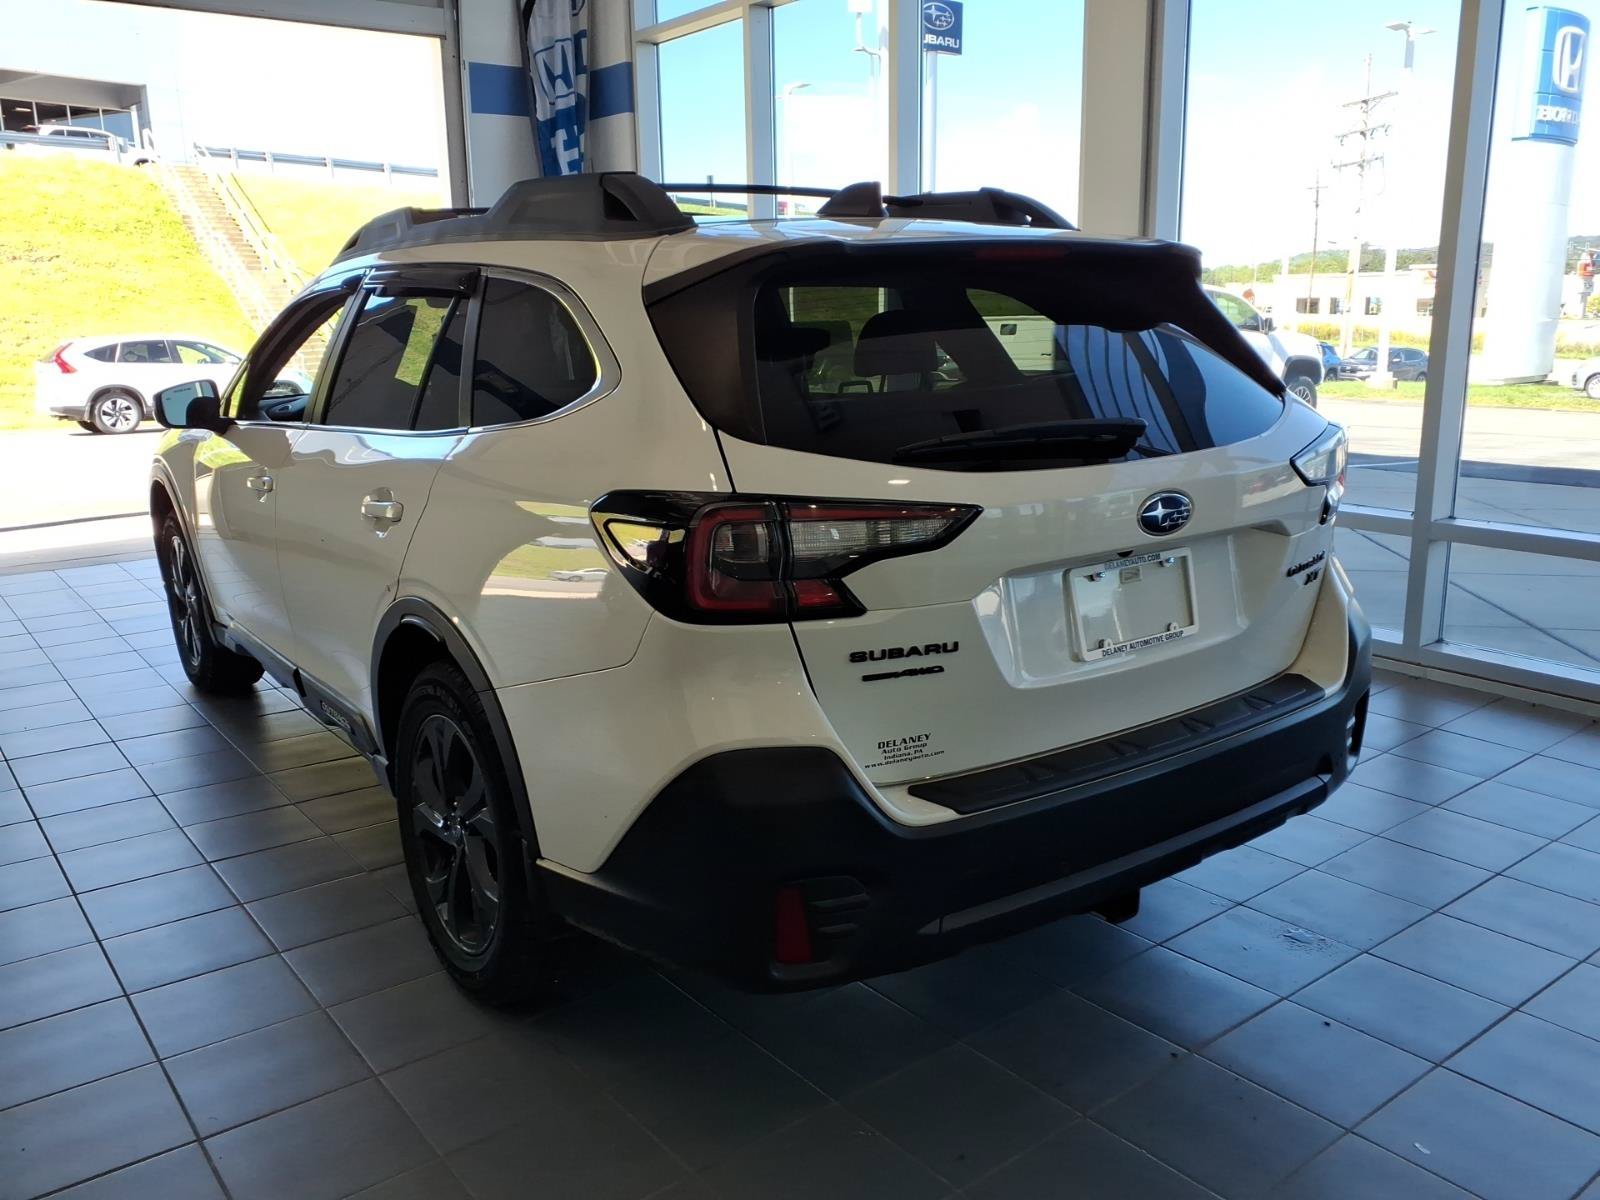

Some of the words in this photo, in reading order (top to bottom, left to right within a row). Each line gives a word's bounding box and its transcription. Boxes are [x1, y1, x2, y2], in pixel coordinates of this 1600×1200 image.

[924, 33, 960, 48] UBARU
[1102, 642, 1128, 656] DELANEY
[1129, 634, 1164, 649] AUTOMOTIVE
[1165, 630, 1184, 640] GROUP
[849, 641, 959, 663] SUBARU
[878, 733, 931, 749] DELANEY
[904, 743, 927, 751] Group
